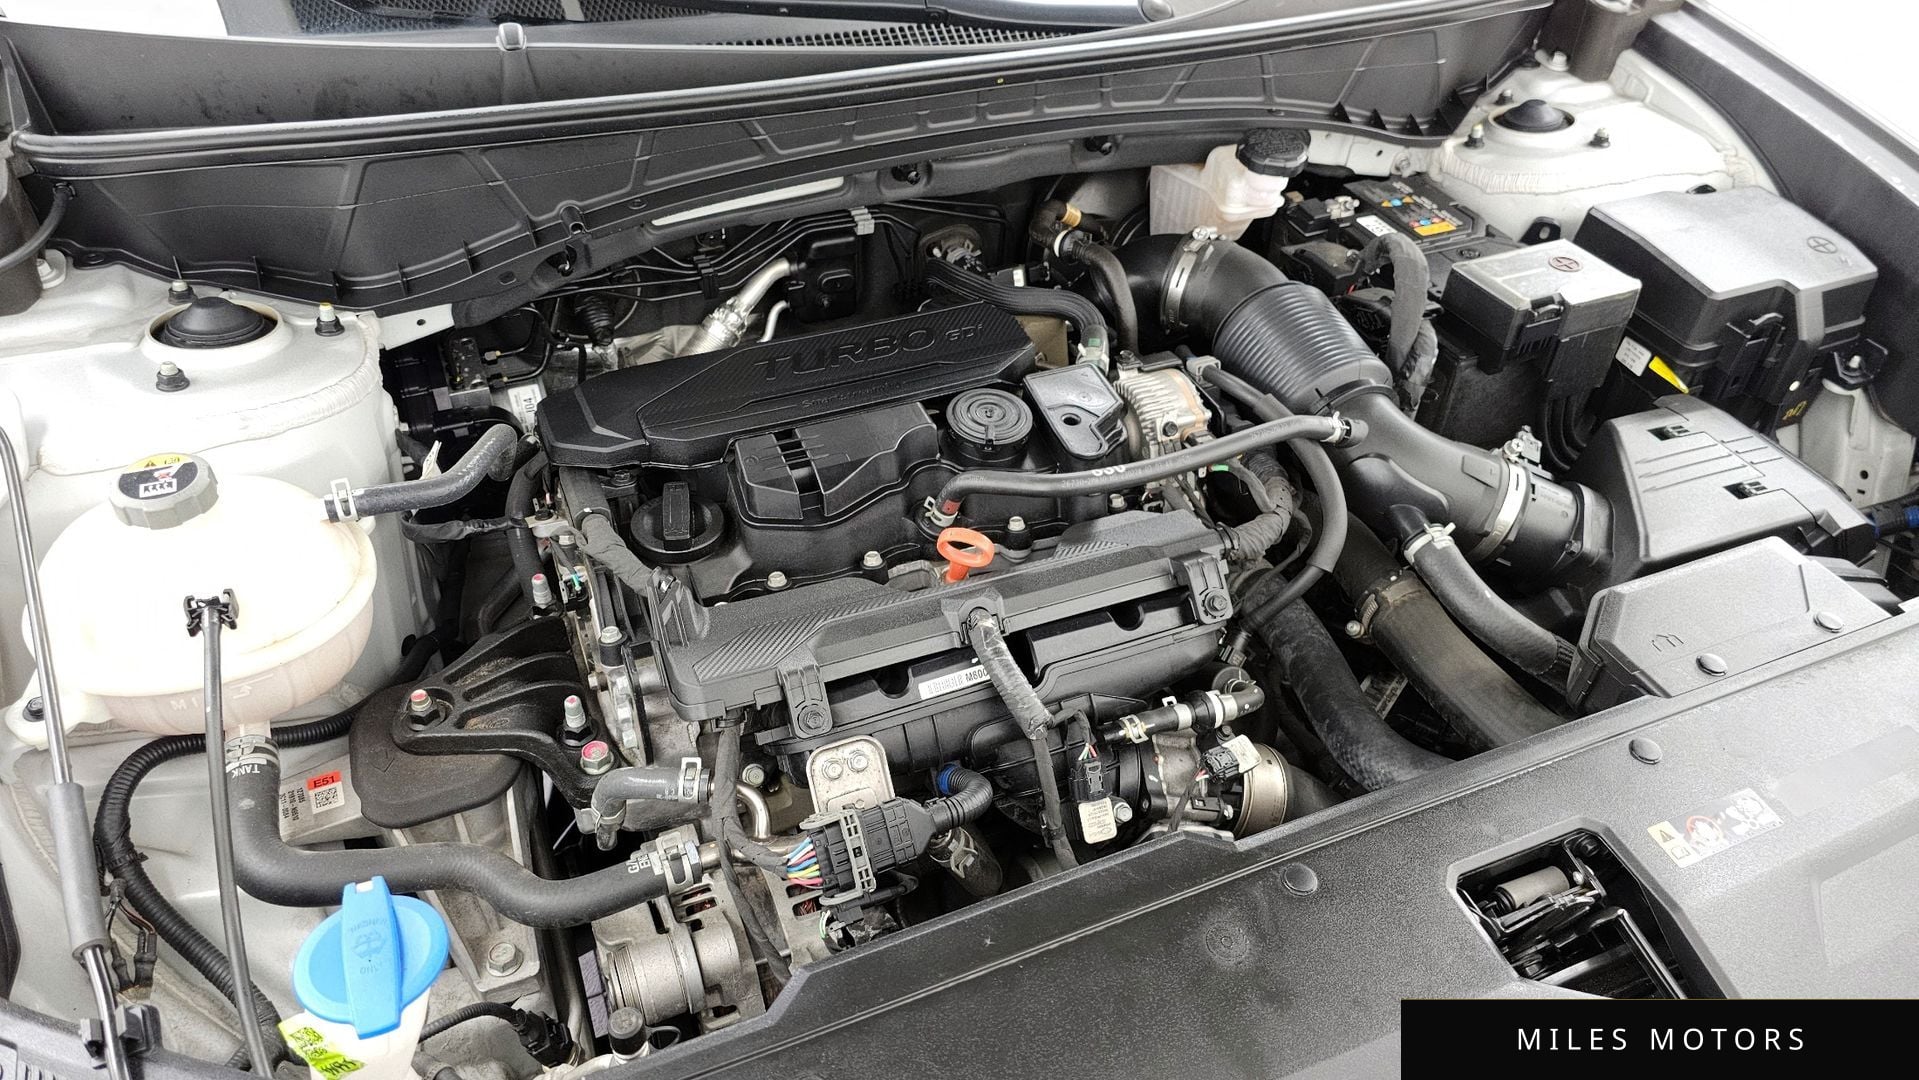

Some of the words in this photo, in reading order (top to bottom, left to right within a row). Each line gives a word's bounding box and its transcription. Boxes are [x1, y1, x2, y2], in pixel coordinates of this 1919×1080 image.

[753, 329, 936, 381] TURBO
[231, 764, 261, 778] TANK
[313, 775, 335, 789] E51
